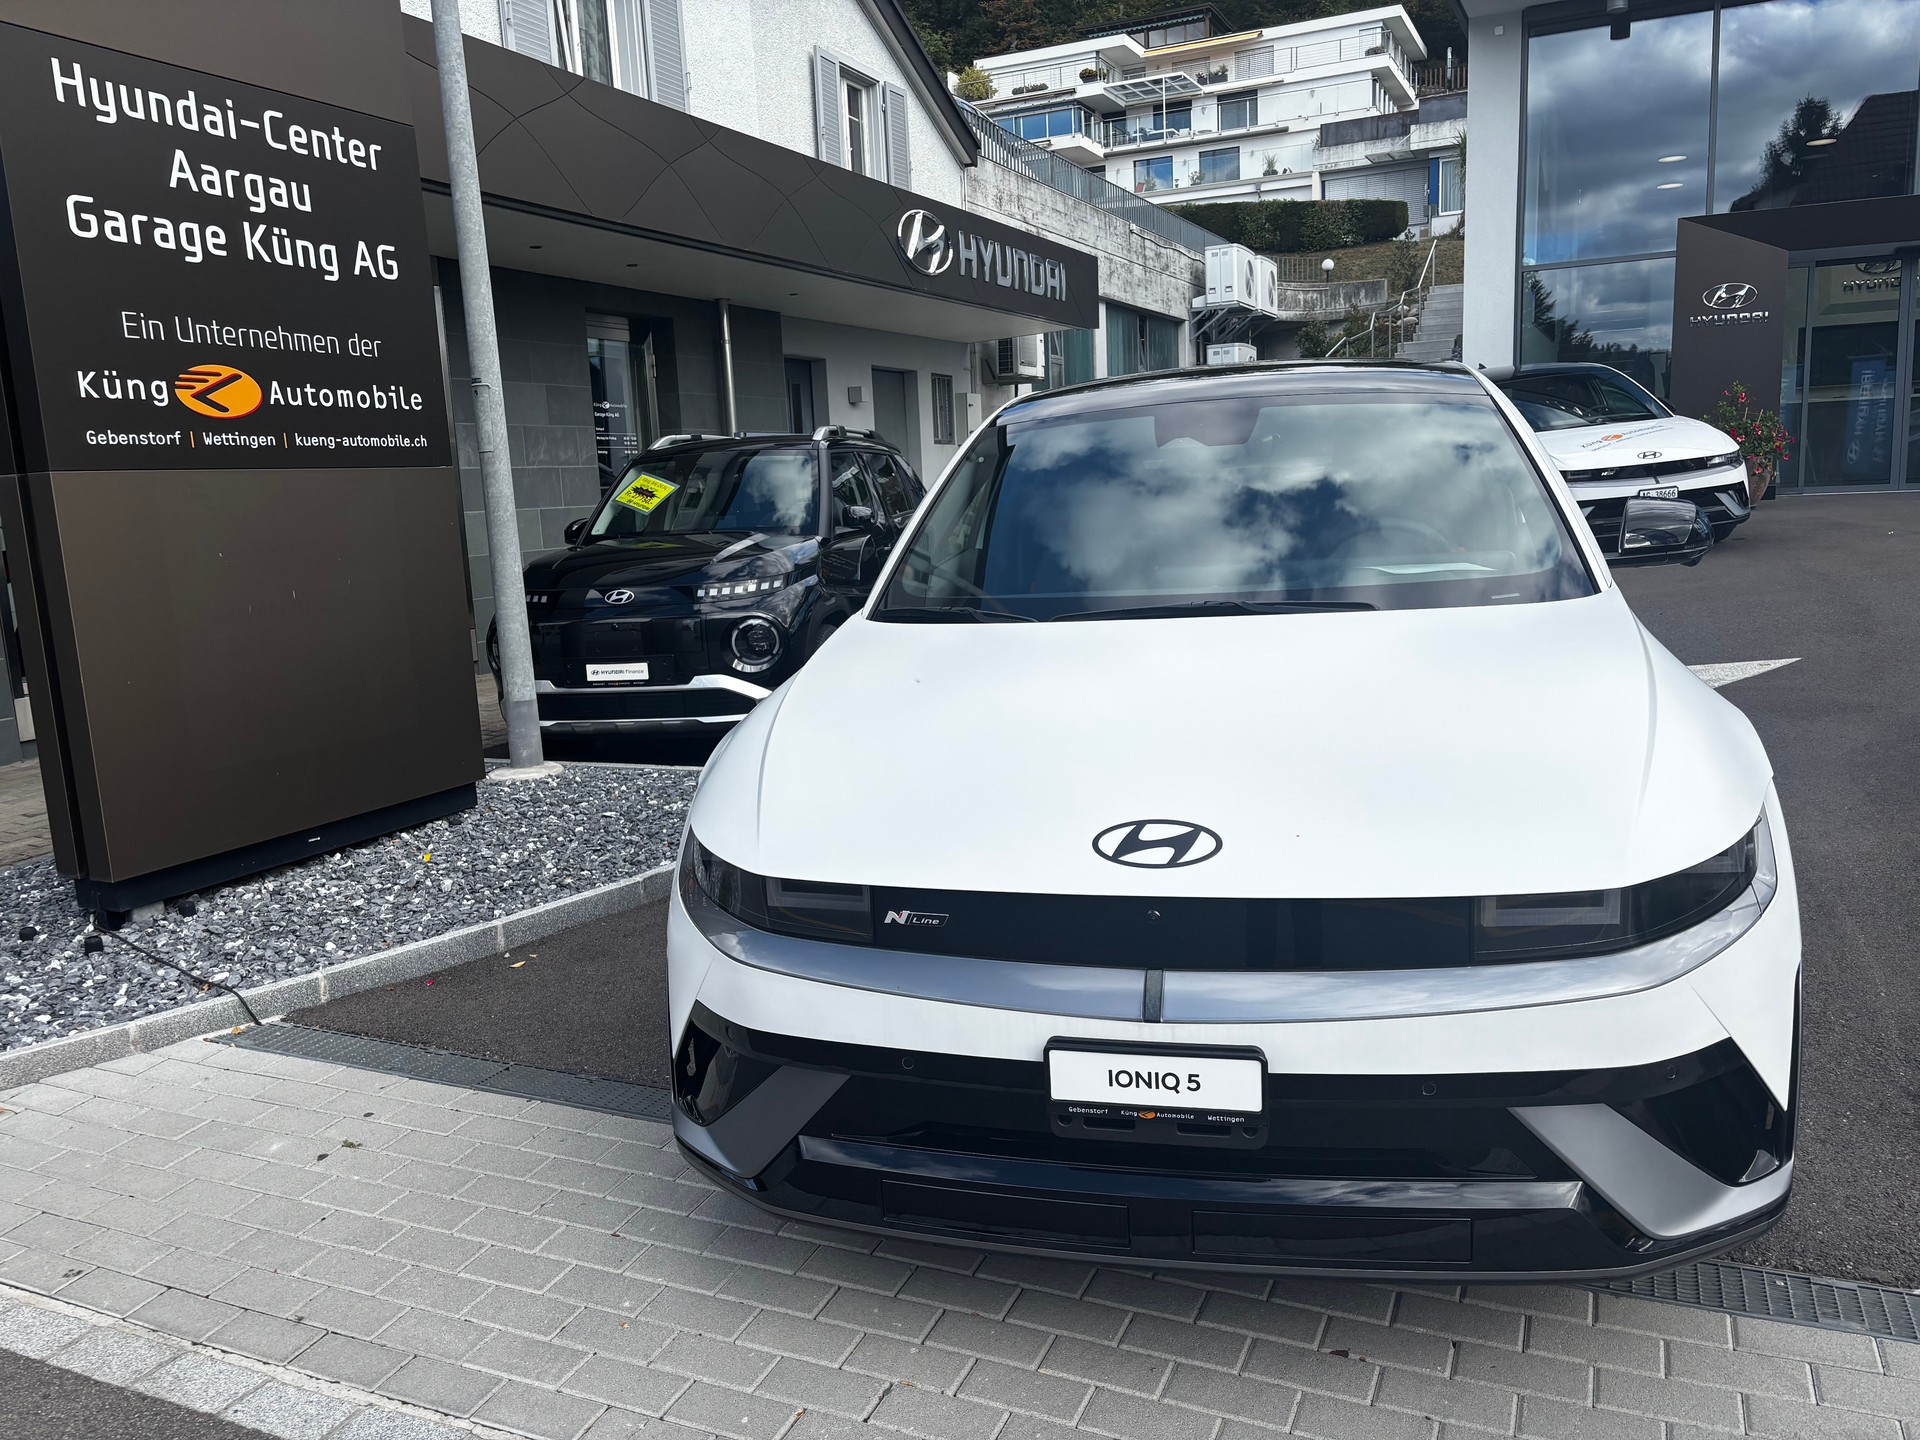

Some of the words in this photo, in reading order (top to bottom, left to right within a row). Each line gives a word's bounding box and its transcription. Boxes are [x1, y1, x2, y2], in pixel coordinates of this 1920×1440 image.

[50, 57, 382, 171] Hyundai-Center
[169, 149, 312, 214] Aargau
[66, 194, 227, 263] Garage
[243, 221, 339, 281] Küng
[354, 241, 399, 280] AG
[958, 230, 1067, 302] HYUNDAI
[121, 311, 165, 341] Ein
[175, 316, 340, 356] Unternehmen
[348, 333, 382, 358] der
[1690, 311, 1769, 328] HYUNDAI
[77, 370, 168, 406] Küng
[270, 381, 423, 410] Automobile
[86, 430, 182, 446] Gebenstorf
[203, 432, 276, 448] Wettingen
[295, 433, 428, 449] kueng-automobile.ch
[884, 910, 910, 924] N
[912, 917, 940, 925] Line
[1108, 1069, 1181, 1094] IONIQ
[1187, 1073, 1201, 1092] 5
[1068, 1106, 1109, 1115] Gebenstorf
[1121, 1109, 1138, 1117] Küng
[1157, 1112, 1195, 1120] Automobile
[1207, 1115, 1245, 1123] Wettingen
